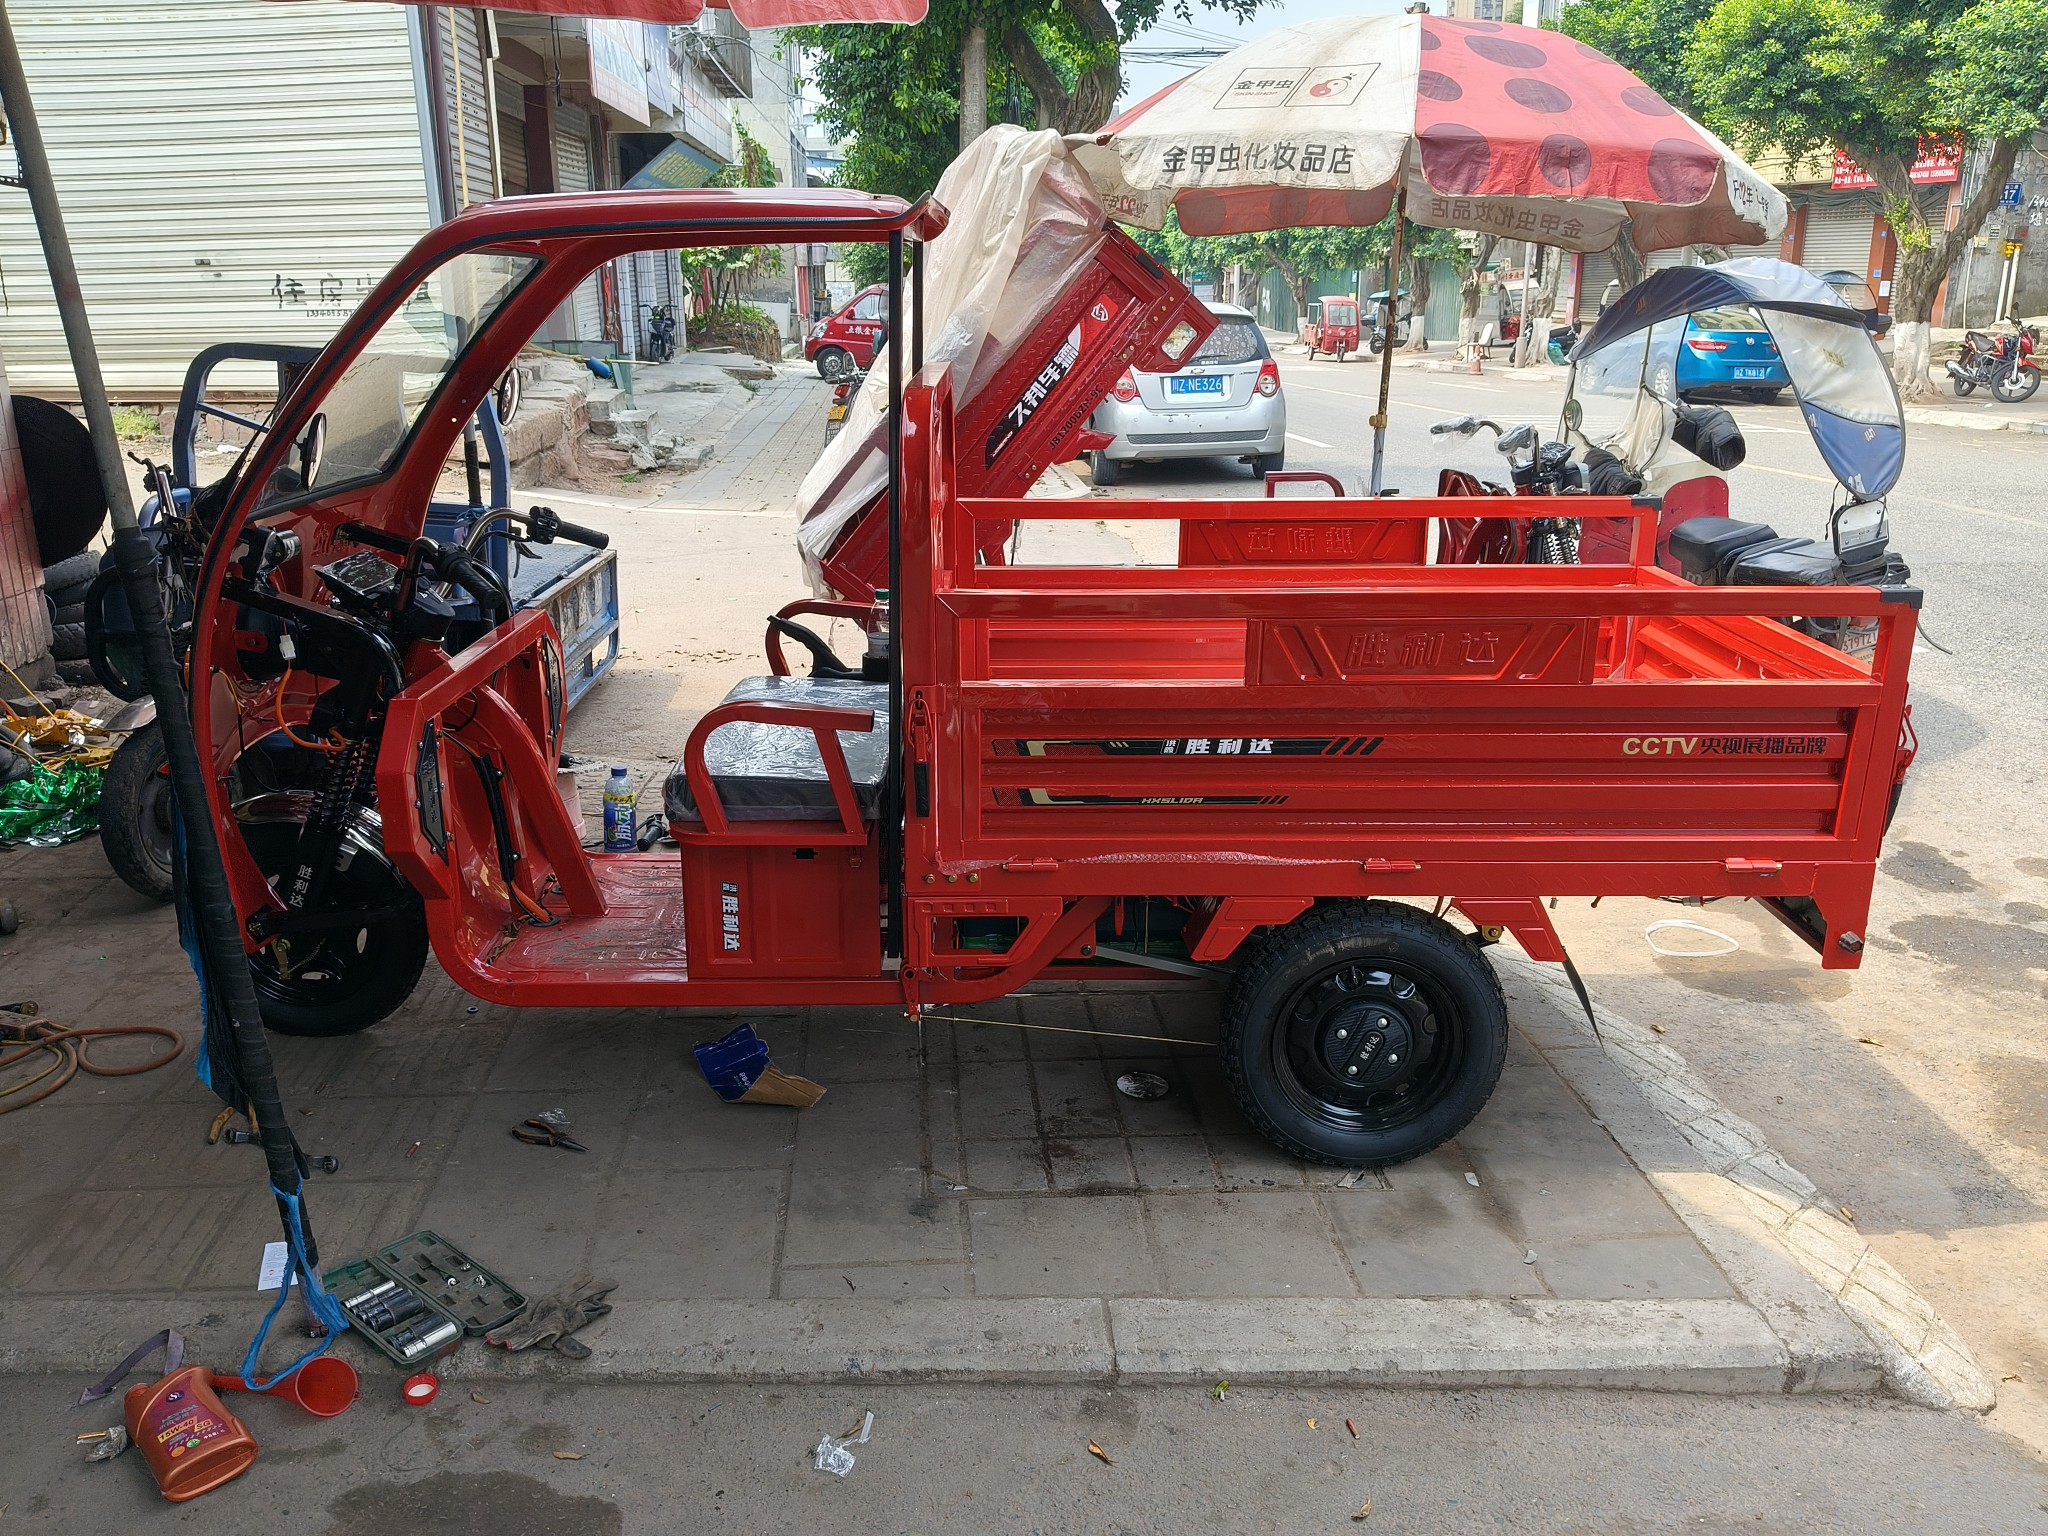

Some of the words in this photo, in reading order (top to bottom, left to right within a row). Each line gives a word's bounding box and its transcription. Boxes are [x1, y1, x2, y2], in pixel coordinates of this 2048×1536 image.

[1234, 80, 1294, 89] 金甲虫
[1162, 141, 1356, 174] 金甲虫化妆品店
[1184, 738, 1274, 755] 胜利达
[1622, 737, 1698, 755] CCTV
[1700, 737, 1827, 755] 央视展播品牌
[614, 803, 633, 841] 脉动
[289, 865, 313, 908] 胜利达
[722, 895, 740, 951] 胜利达
[1360, 1036, 1380, 1060] 胜利达
[159, 1419, 194, 1440] 15W-40
[196, 1421, 211, 1430] SG
